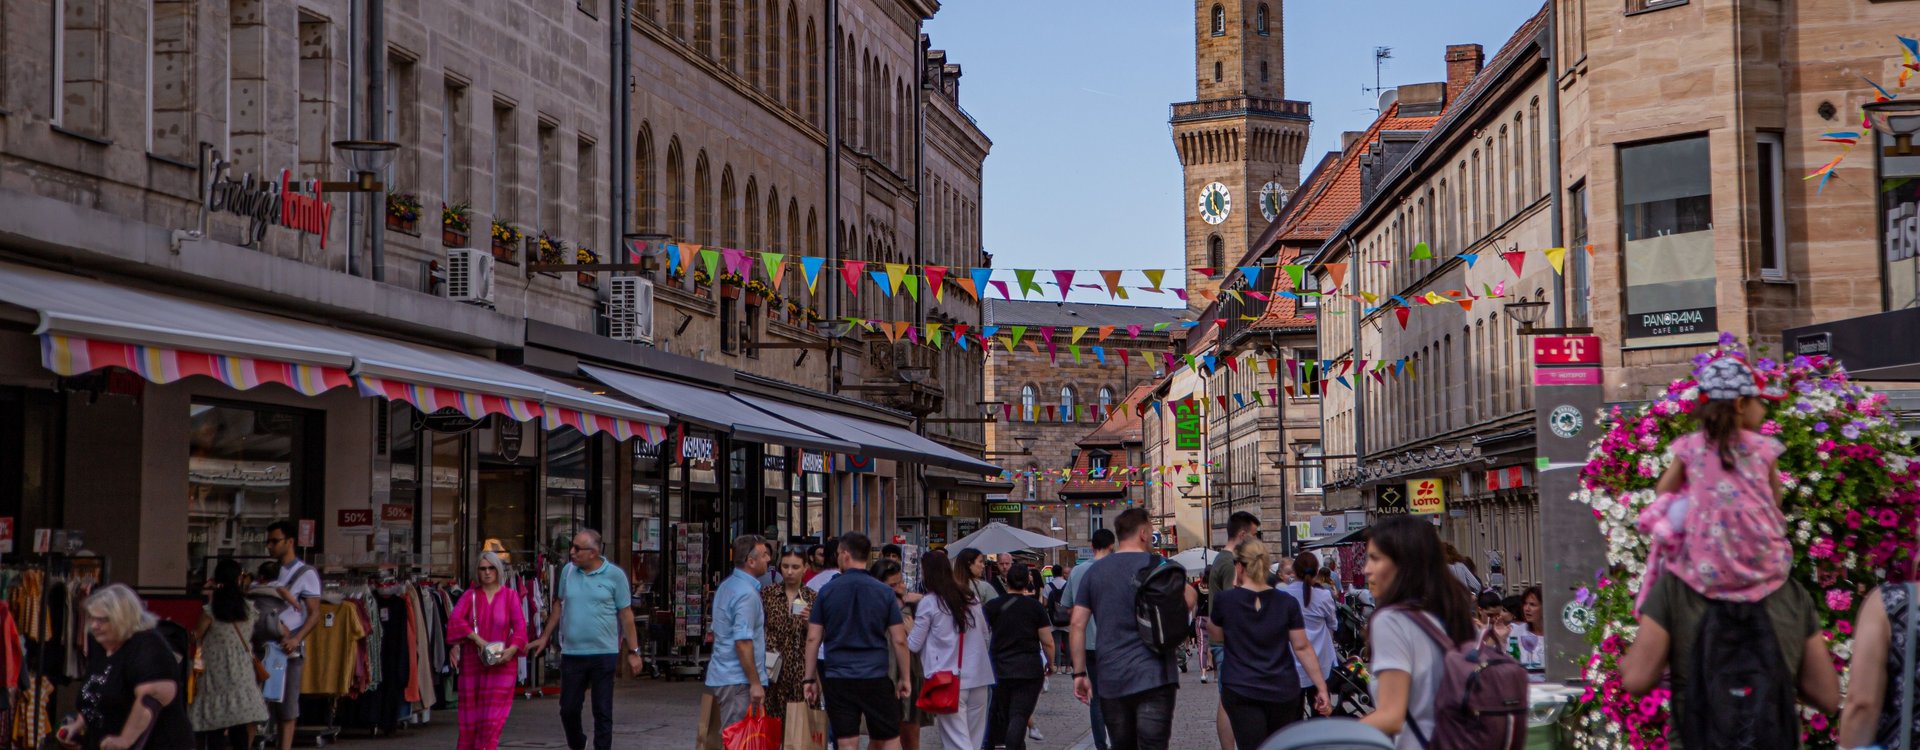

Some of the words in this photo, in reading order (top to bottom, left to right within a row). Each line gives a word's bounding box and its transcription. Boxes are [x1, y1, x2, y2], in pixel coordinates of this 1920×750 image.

[281, 167, 332, 249] family
[1643, 310, 1703, 327] PANORAMA
[1653, 326, 1671, 335] CAFÉ
[1680, 325, 1695, 333] BAR
[683, 436, 714, 460] OSIANDER
[1412, 497, 1441, 506] LOTTO
[387, 506, 407, 517] 50%
[1377, 506, 1407, 514] AURA
[344, 512, 366, 523] 50%
